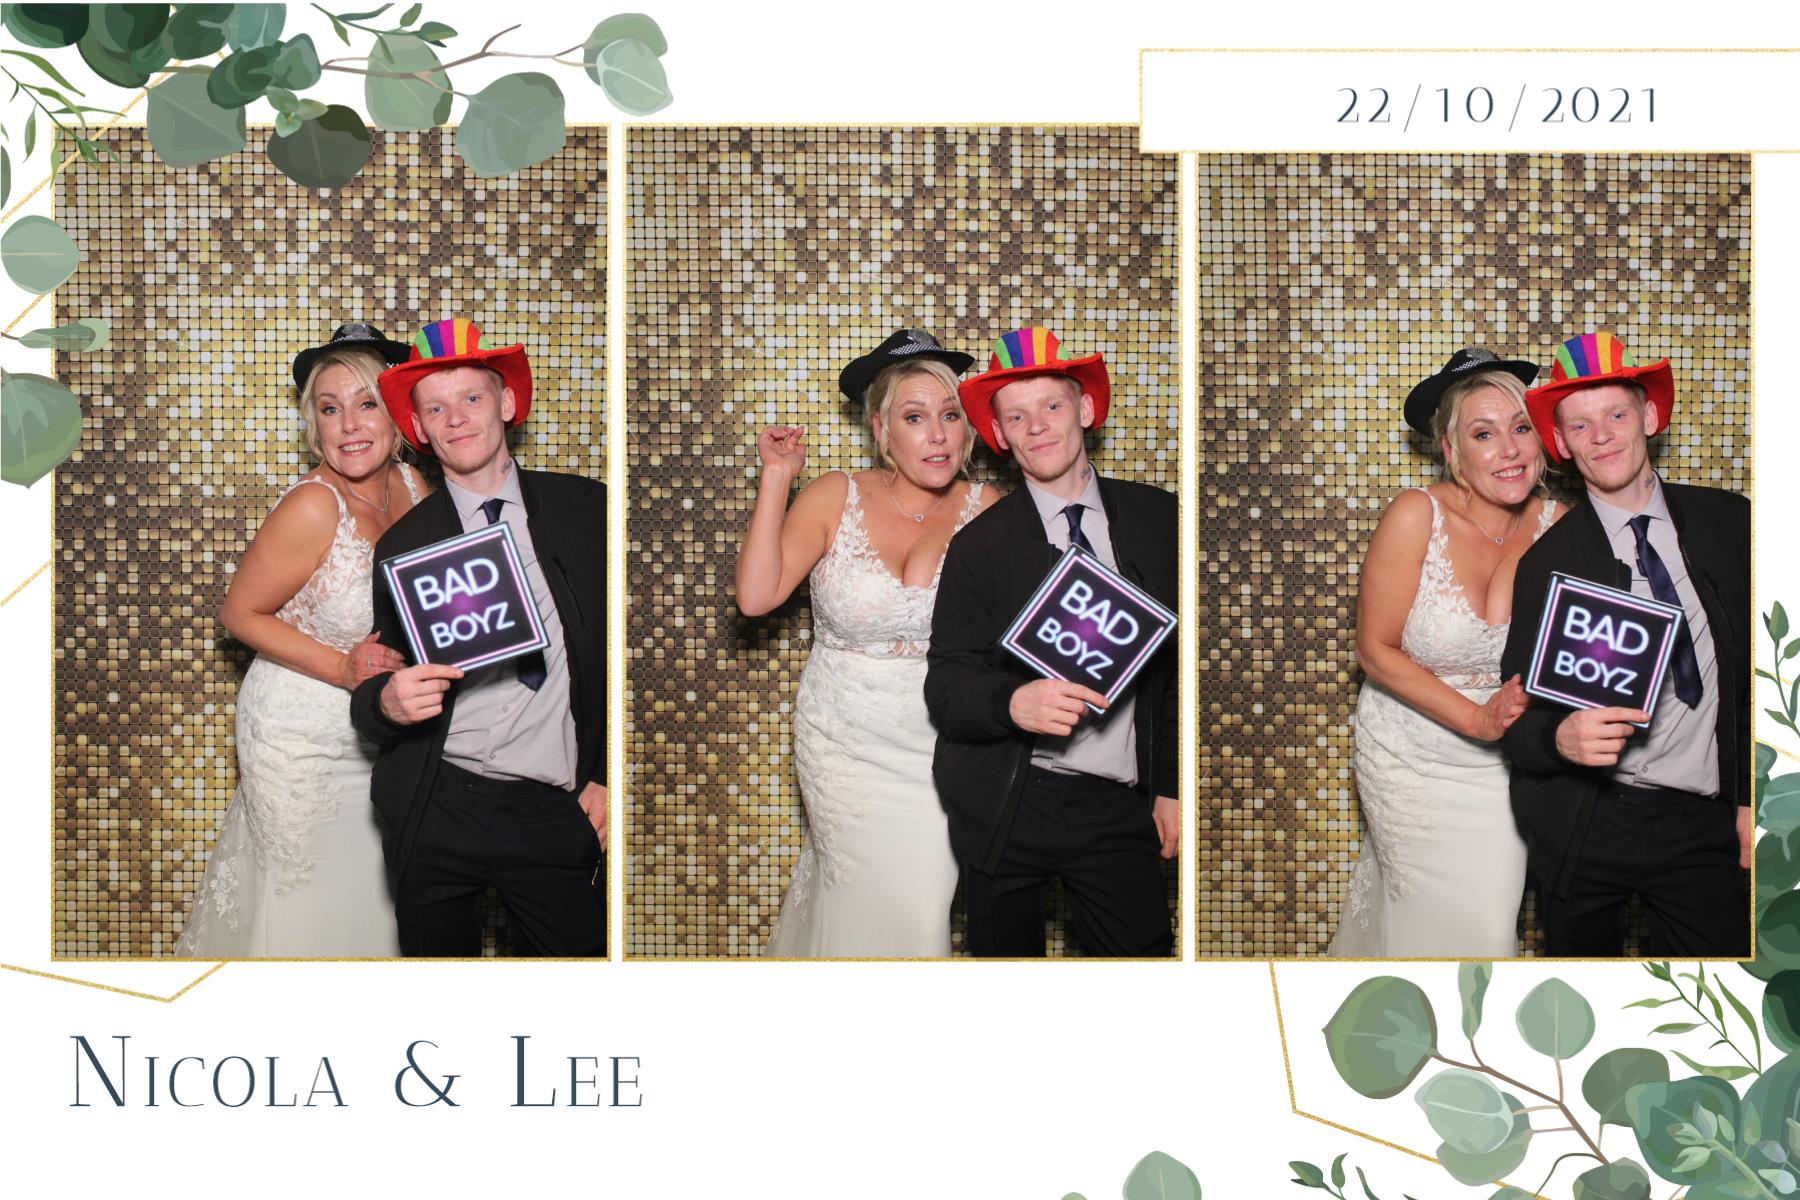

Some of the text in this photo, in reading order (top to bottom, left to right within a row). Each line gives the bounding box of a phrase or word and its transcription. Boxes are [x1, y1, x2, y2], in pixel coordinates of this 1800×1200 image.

[414, 558, 499, 611] BAD
[430, 602, 516, 648] BOYZ
[1059, 579, 1139, 645] BAD
[1563, 605, 1650, 656] BAD
[1036, 617, 1114, 680] BOYZ
[1554, 650, 1638, 696] BOYZ
